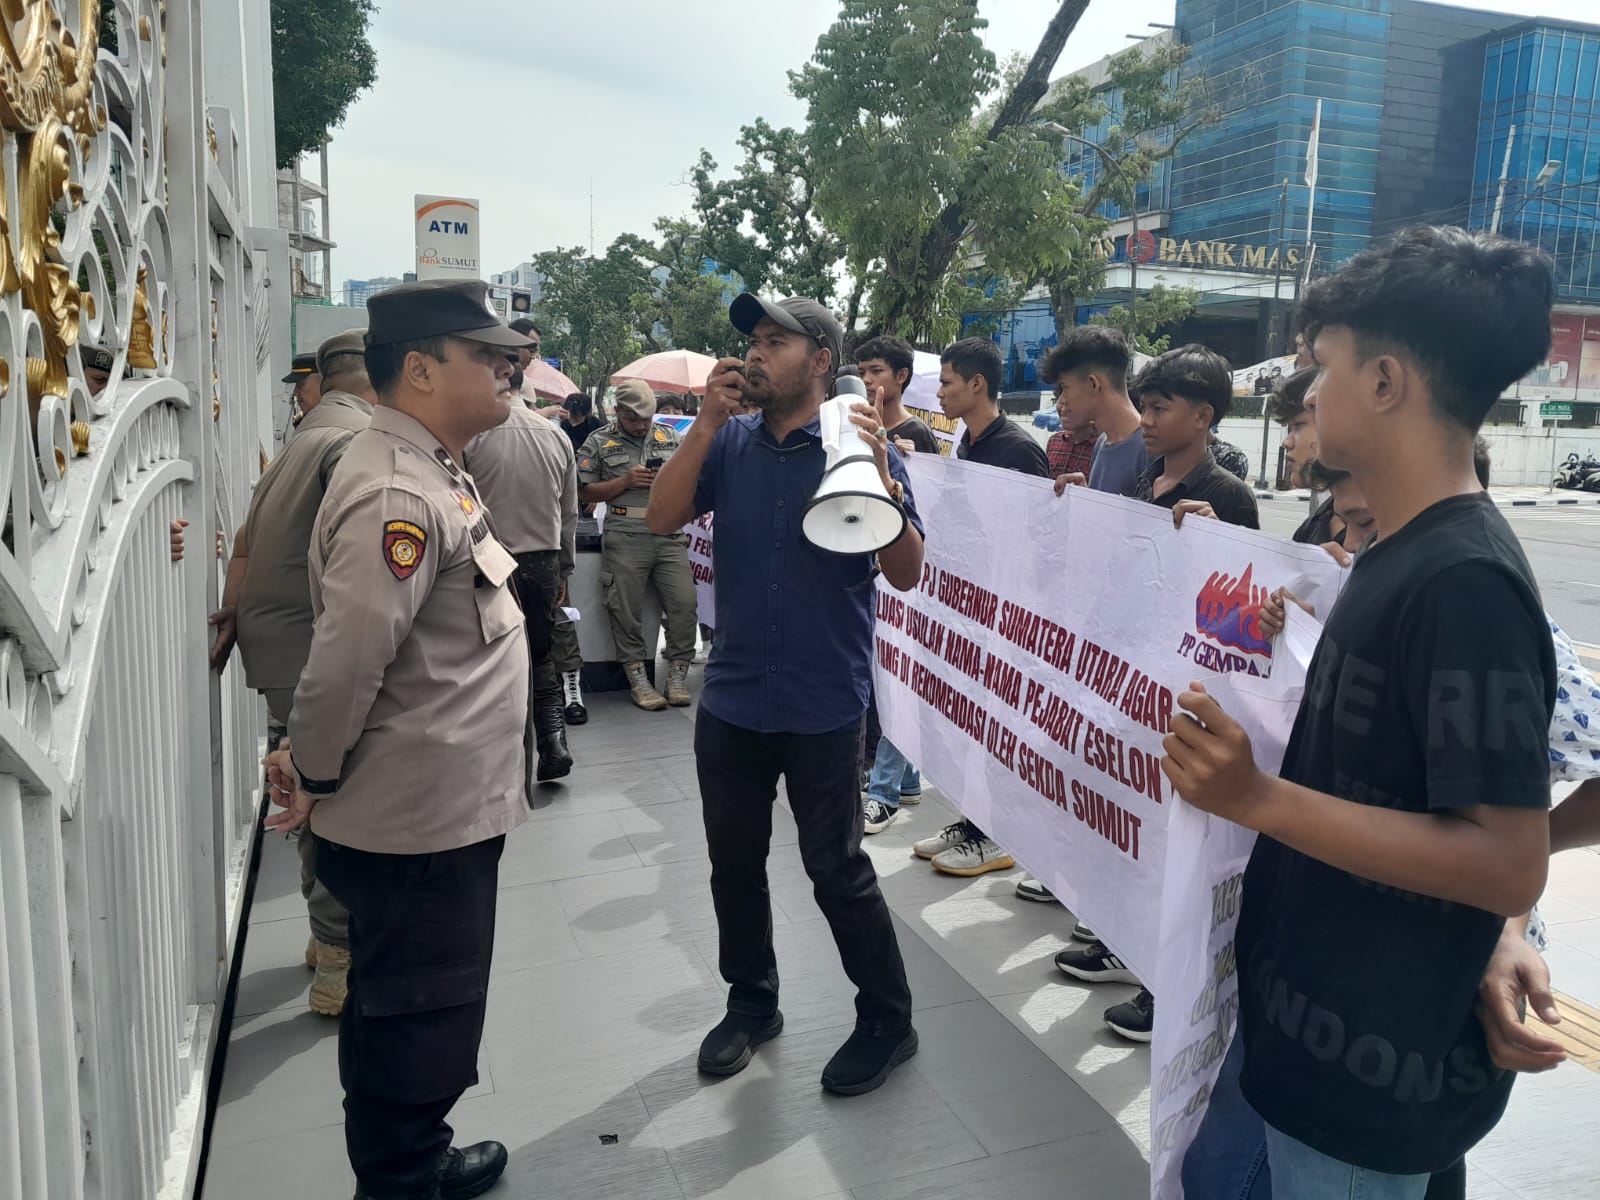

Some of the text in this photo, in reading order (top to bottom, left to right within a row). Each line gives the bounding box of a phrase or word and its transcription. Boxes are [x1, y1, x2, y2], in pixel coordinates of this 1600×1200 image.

[429, 220, 468, 235] ATM
[1158, 237, 1300, 271] BANK MAS
[921, 562, 1173, 734] PJ GUBERNUR SUMATERA UTARA AGAR
[1177, 632, 1272, 679] PP GEMPA-
[876, 633, 1141, 860] YANG DI REKOMENDASI OLEH SEKDA SUMUT
[906, 605, 945, 656] USULAN
[944, 629, 1022, 710] NAMA-NAMA
[1023, 678, 1083, 755] PEJABAT
[1084, 720, 1162, 804] ESELON
